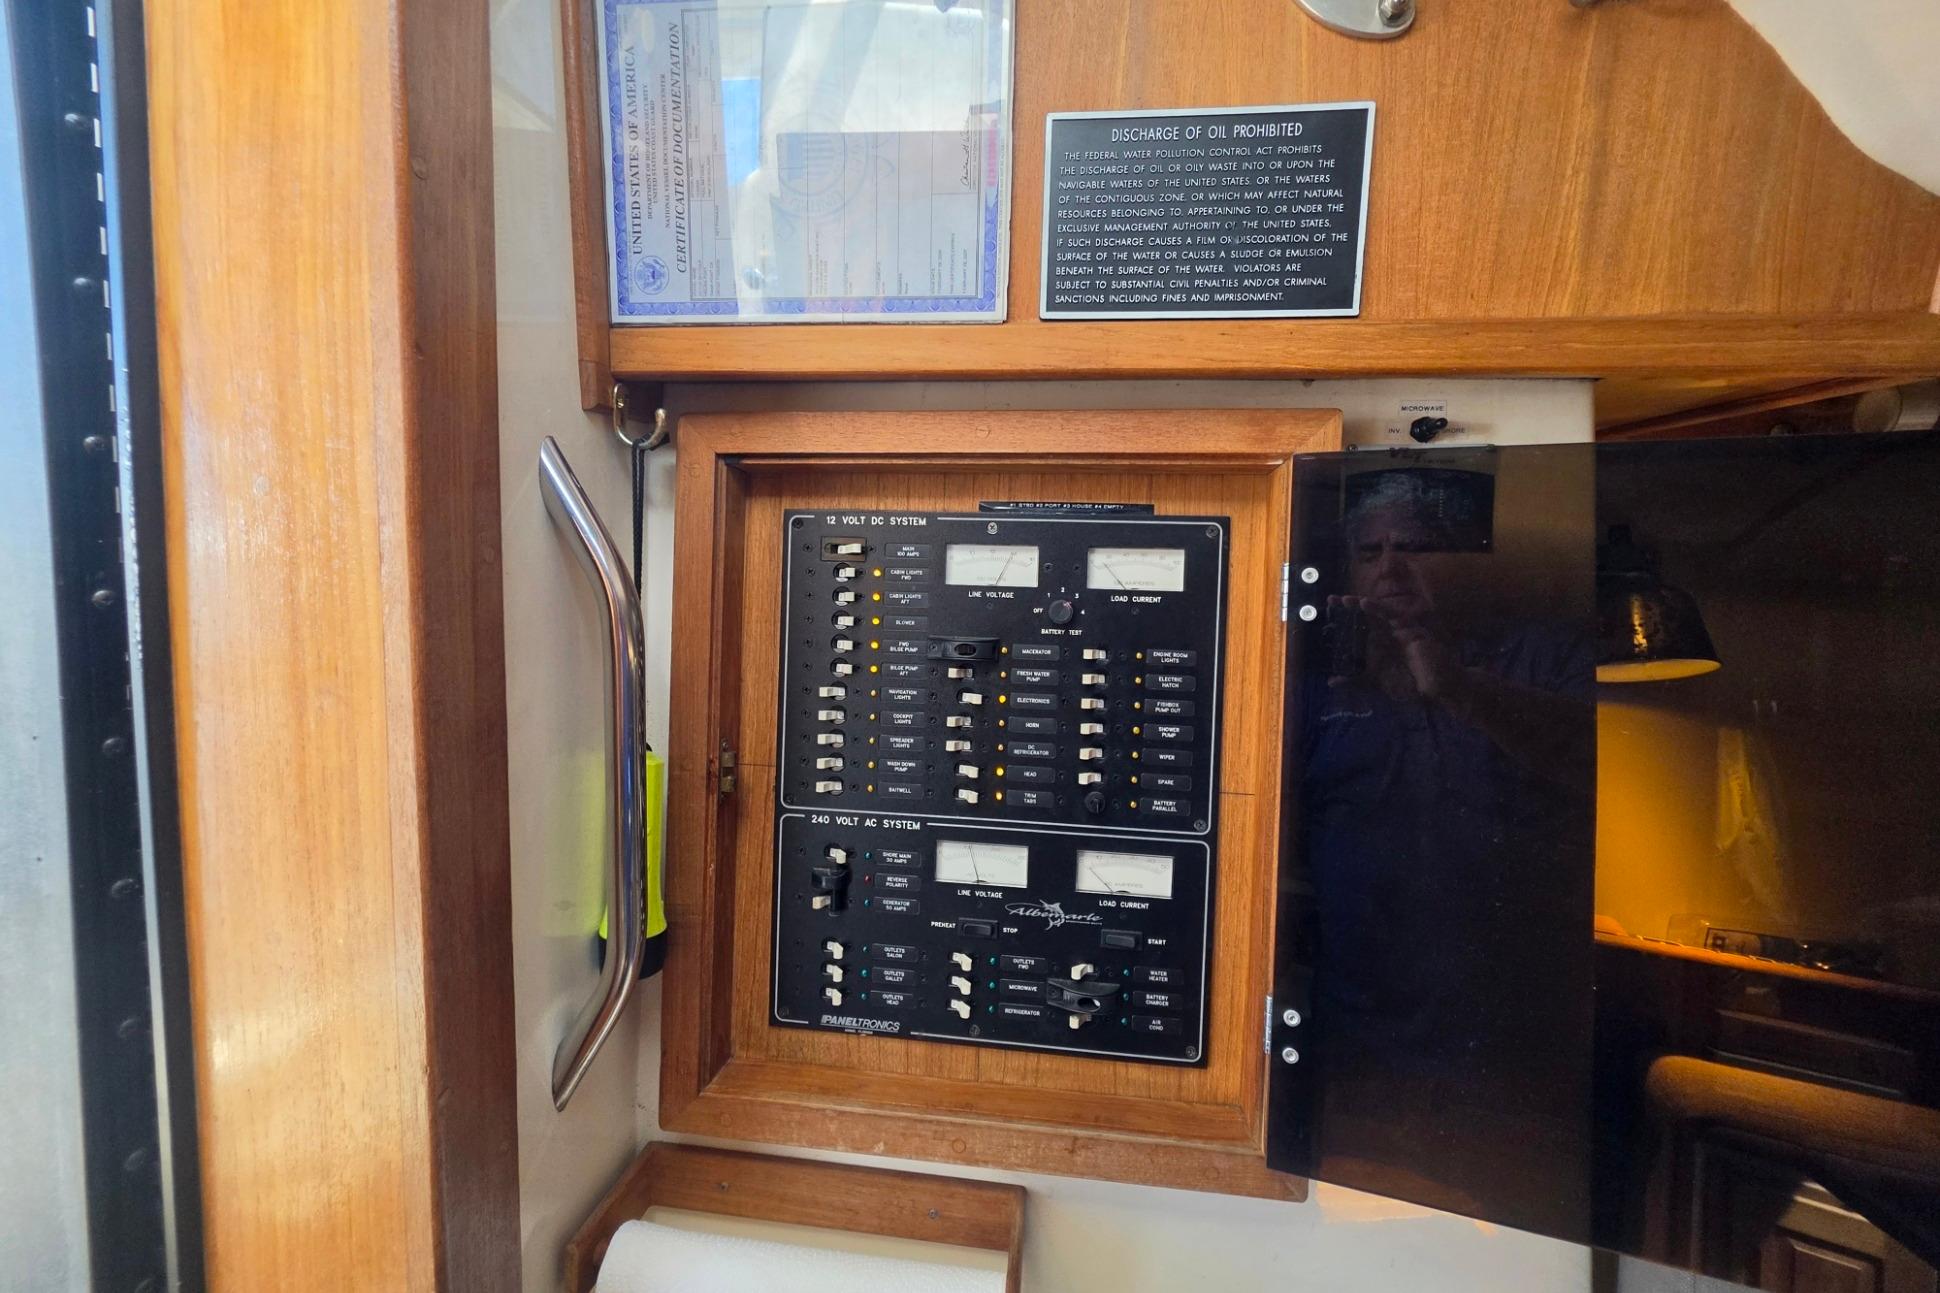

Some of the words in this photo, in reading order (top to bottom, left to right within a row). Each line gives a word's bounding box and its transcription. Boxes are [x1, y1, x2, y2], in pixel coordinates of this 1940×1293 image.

[626, 46, 638, 118] AMERICA
[669, 22, 684, 154] DOCUMENTATION
[629, 120, 640, 141] OF
[1111, 126, 1180, 142] DISCHARGE
[1185, 125, 1202, 140] OF
[1207, 124, 1227, 139] OIL
[1233, 122, 1303, 138] PROHIBITED
[1065, 151, 1080, 160] THE
[1084, 151, 1118, 160] FEDERAL
[1123, 149, 1151, 158] WATER
[1155, 148, 1205, 158] POLLUTION
[1208, 146, 1251, 156] CONTROL
[1255, 146, 1273, 155] ACT
[1277, 144, 1322, 154] PROHIBITS
[630, 144, 642, 198] STATES
[673, 156, 685, 176] OF
[1059, 166, 1075, 175] THE
[1079, 164, 1128, 174] DISCHARGE
[1133, 164, 1145, 173] OF
[1149, 164, 1163, 172] OIL
[1168, 163, 1181, 172] OR
[1184, 162, 1204, 172] OILY
[1208, 161, 1238, 171] WASTE
[1242, 161, 1265, 170] INTO
[1268, 160, 1282, 170] OR
[1286, 159, 1314, 169] UPON
[1318, 158, 1335, 168] THE
[1058, 180, 1106, 189] NAVIGABLE
[1109, 179, 1143, 188] WATERS
[1147, 178, 1159, 187] OF
[1164, 178, 1180, 187] THE
[1184, 177, 1217, 187] UNITED
[1256, 175, 1270, 185] OR
[1274, 175, 1291, 184] THE
[1295, 174, 1330, 184] WATERS
[1058, 194, 1070, 204] OF
[1075, 194, 1090, 203] THE
[1094, 193, 1155, 203] CONTIGUOUS
[1190, 192, 1204, 201] OR
[1208, 191, 1240, 200] WHICH
[1243, 190, 1264, 200] MAY
[1266, 189, 1300, 199] AFFECT
[1303, 188, 1343, 198] NATURAL
[632, 200, 643, 255] UNITED
[674, 178, 688, 273] CERTIFICATE
[1055, 266, 1093, 275] BENEATH
[1097, 266, 1114, 275] THE
[1117, 265, 1154, 275] SURFACE
[1157, 265, 1170, 274] OF
[1174, 264, 1191, 274] THE
[1233, 263, 1281, 272] VIOLATORS
[1284, 262, 1302, 272] ARE
[1055, 280, 1090, 289] SUBJECT
[1094, 280, 1107, 289] TO
[1110, 279, 1164, 289] SUBSTANTIAL
[1169, 279, 1190, 288] CIVIL
[1194, 278, 1239, 288] PENALTIES
[1242, 278, 1280, 287] AND/OR
[1283, 276, 1327, 286] CRIMINAL
[1054, 294, 1105, 303] SANCTIONS
[1108, 293, 1158, 303] INCLUDING
[1161, 293, 1187, 302] FINES
[1190, 293, 1210, 302] AND
[826, 516, 836, 524] 12
[842, 516, 866, 525] VOLT
[871, 516, 884, 525] DC
[890, 517, 927, 526] SYSTEM
[811, 815, 830, 824] 240
[836, 816, 859, 826] VOLT
[864, 818, 877, 827] AC
[883, 819, 920, 830] SYSTEM
[1120, 901, 1149, 910] CURRENT
